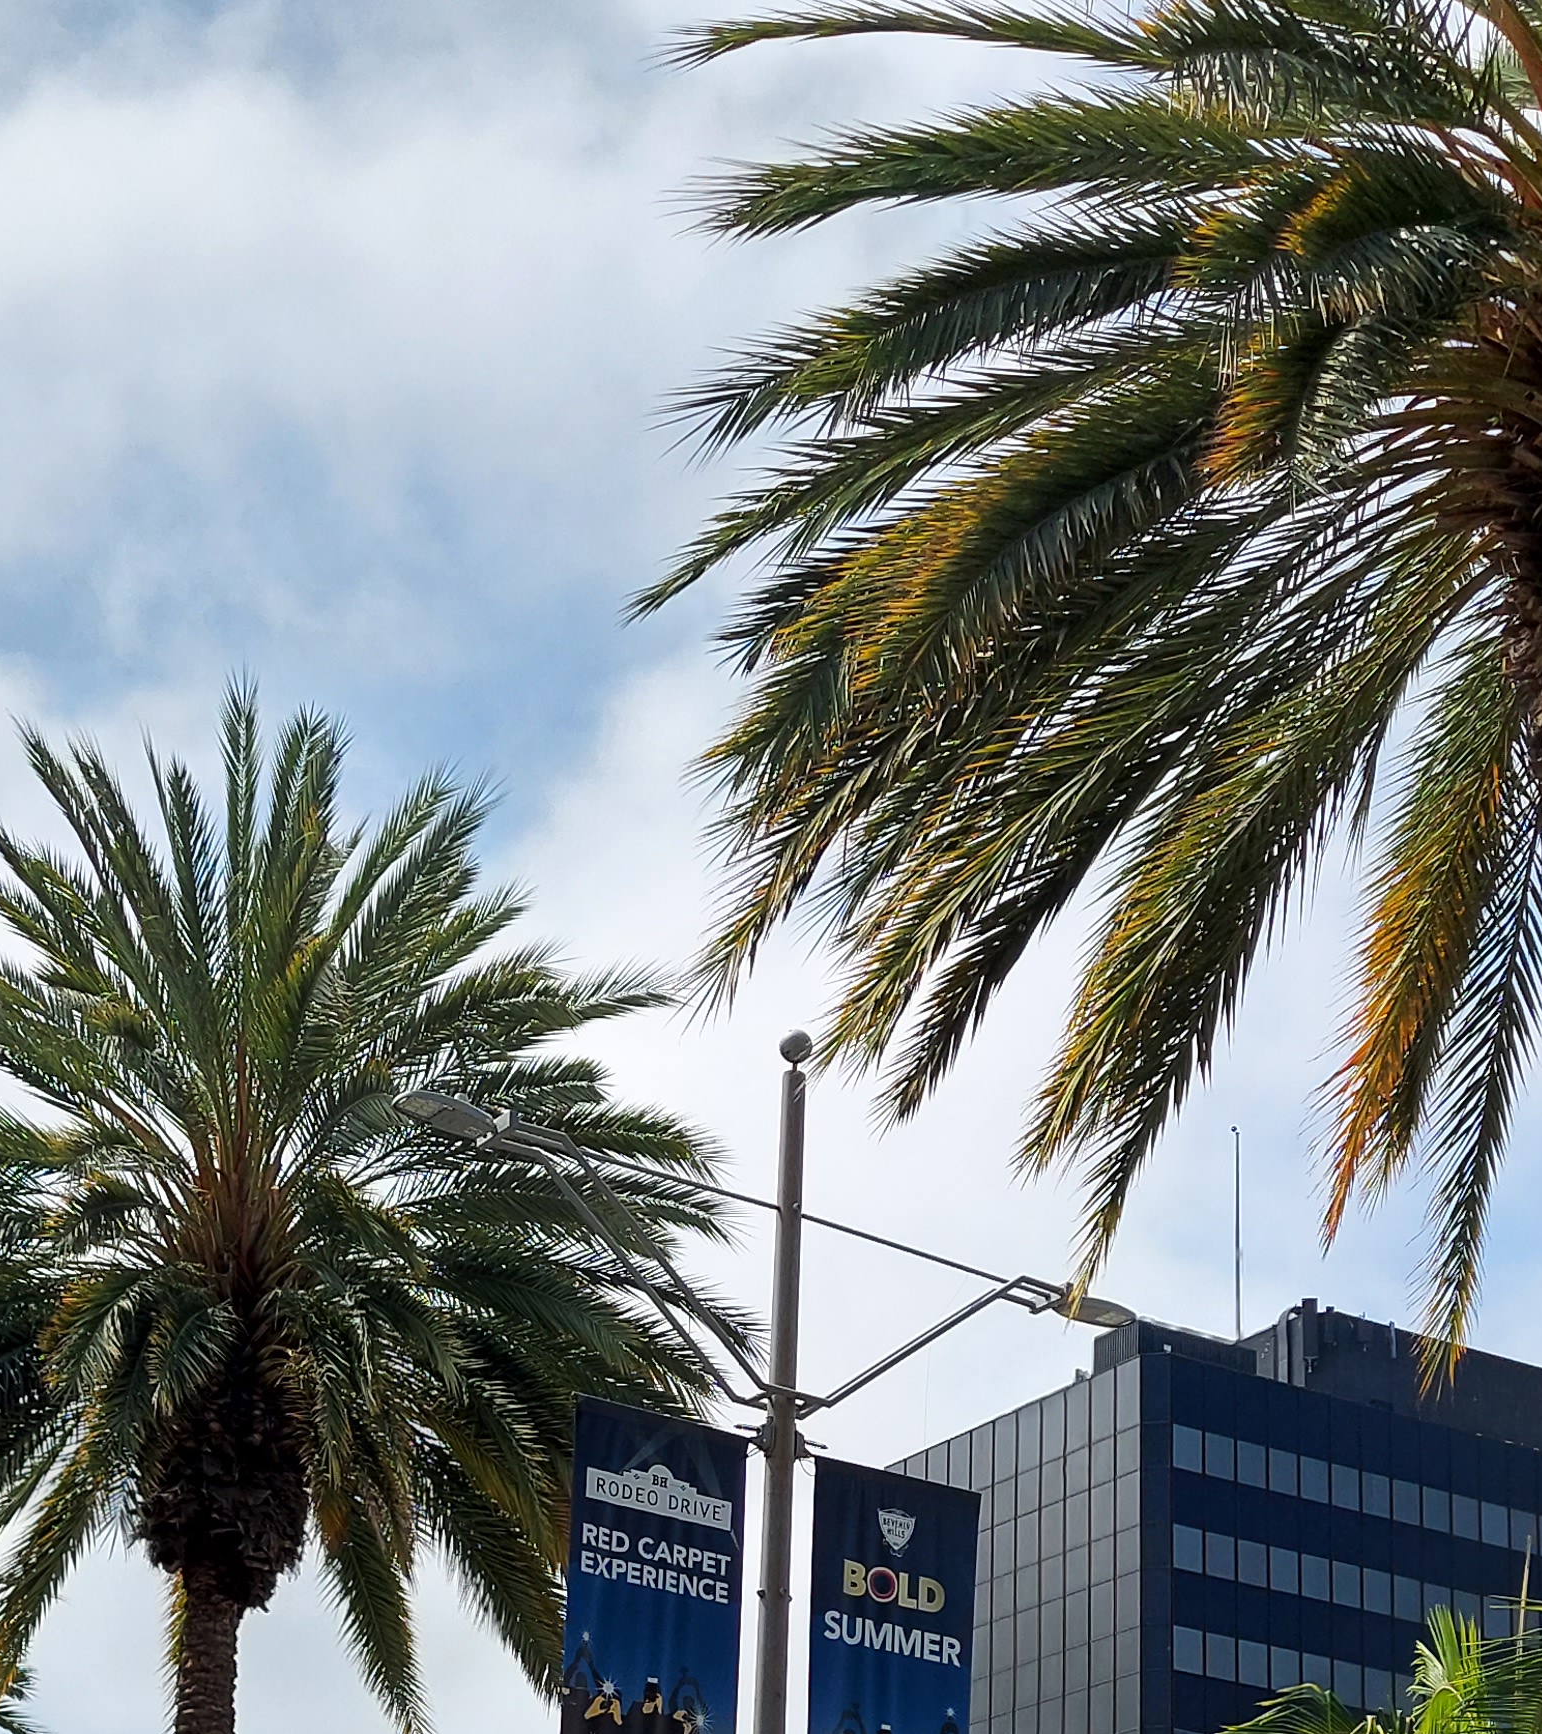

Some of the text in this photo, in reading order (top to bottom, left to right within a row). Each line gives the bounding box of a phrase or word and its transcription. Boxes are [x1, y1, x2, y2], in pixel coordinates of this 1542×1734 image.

[596, 1477, 659, 1507] RODEO
[651, 1474, 668, 1489] BH
[882, 1516, 911, 1531] BEVERLY
[886, 1527, 906, 1540] HILLS
[581, 1522, 732, 1577] RED CARPET
[580, 1550, 729, 1605] EXPERIENCE
[842, 1558, 946, 1614] BOLD
[823, 1610, 962, 1669] SUMMER
